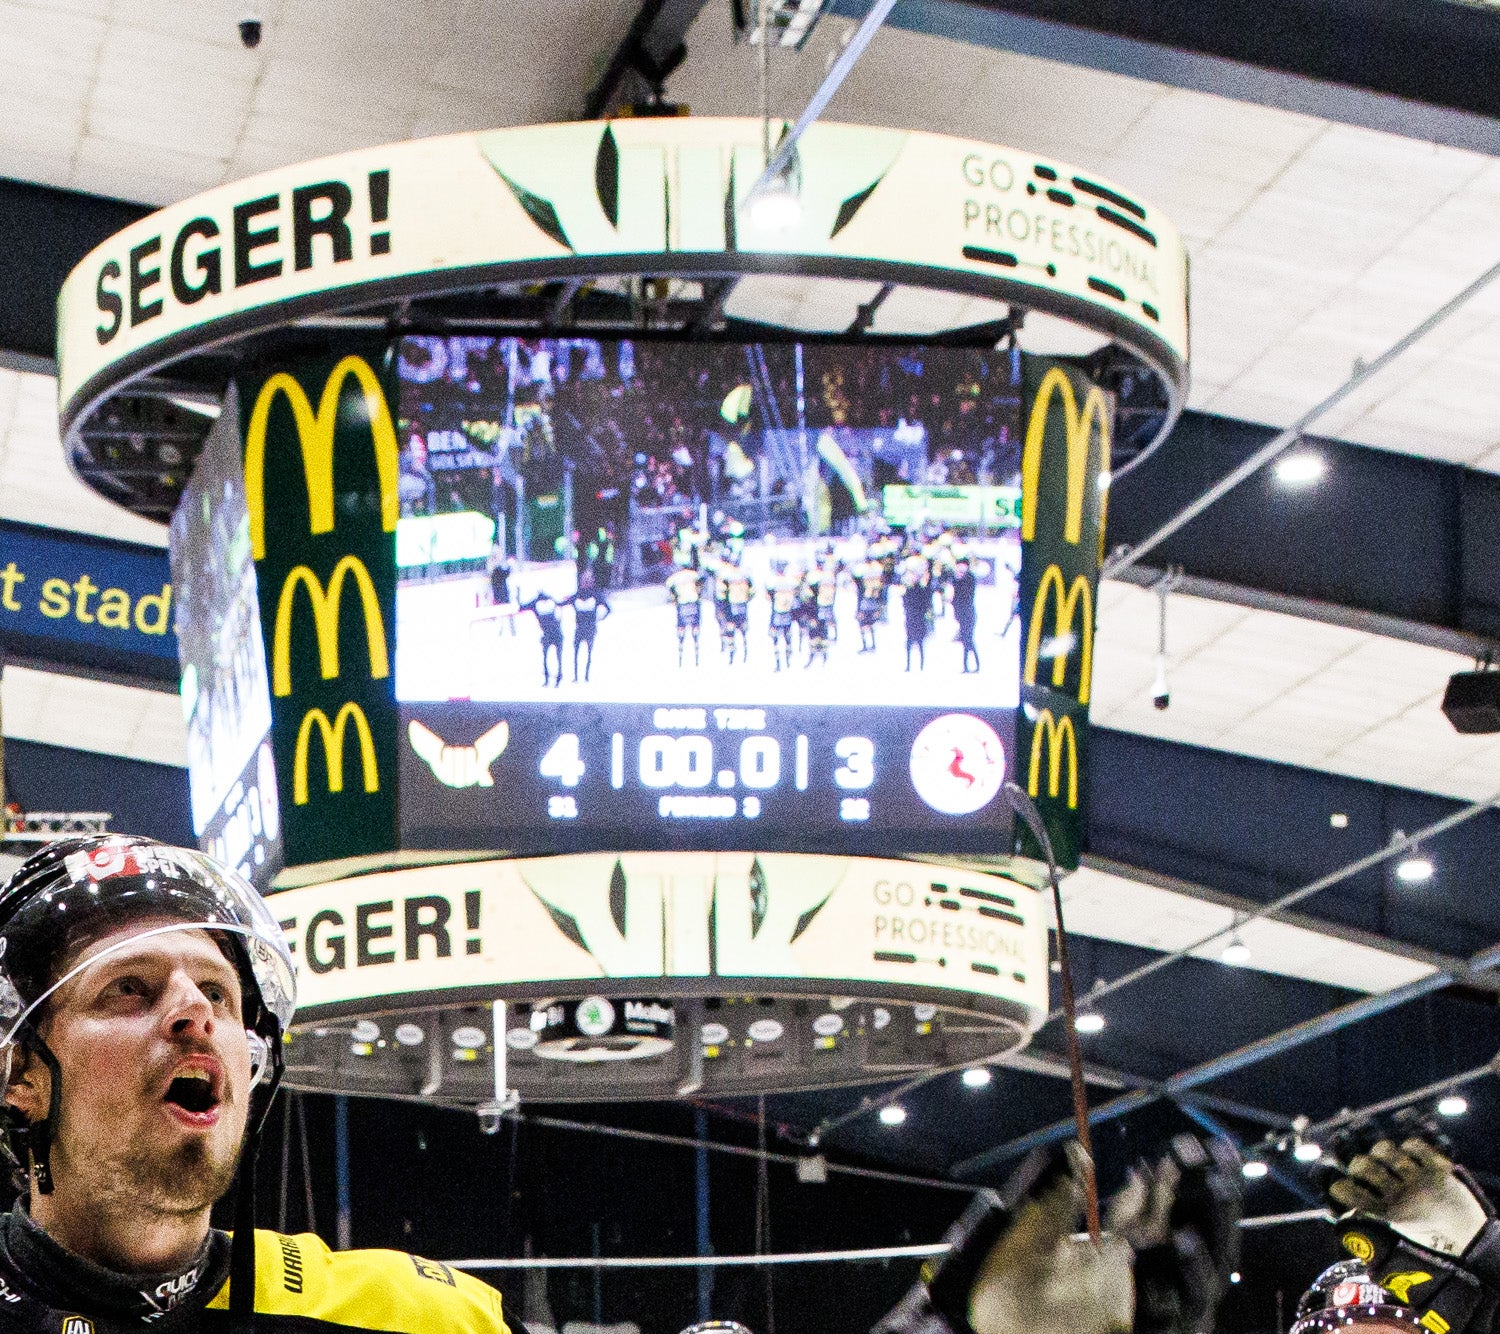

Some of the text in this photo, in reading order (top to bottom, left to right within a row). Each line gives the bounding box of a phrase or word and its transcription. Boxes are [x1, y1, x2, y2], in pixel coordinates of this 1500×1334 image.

[962, 153, 1014, 192] GO
[95, 170, 395, 346] SEGER!
[538, 733, 586, 788] 4
[637, 734, 782, 789] 00.0
[834, 736, 877, 788] 3
[874, 880, 914, 906] GO
